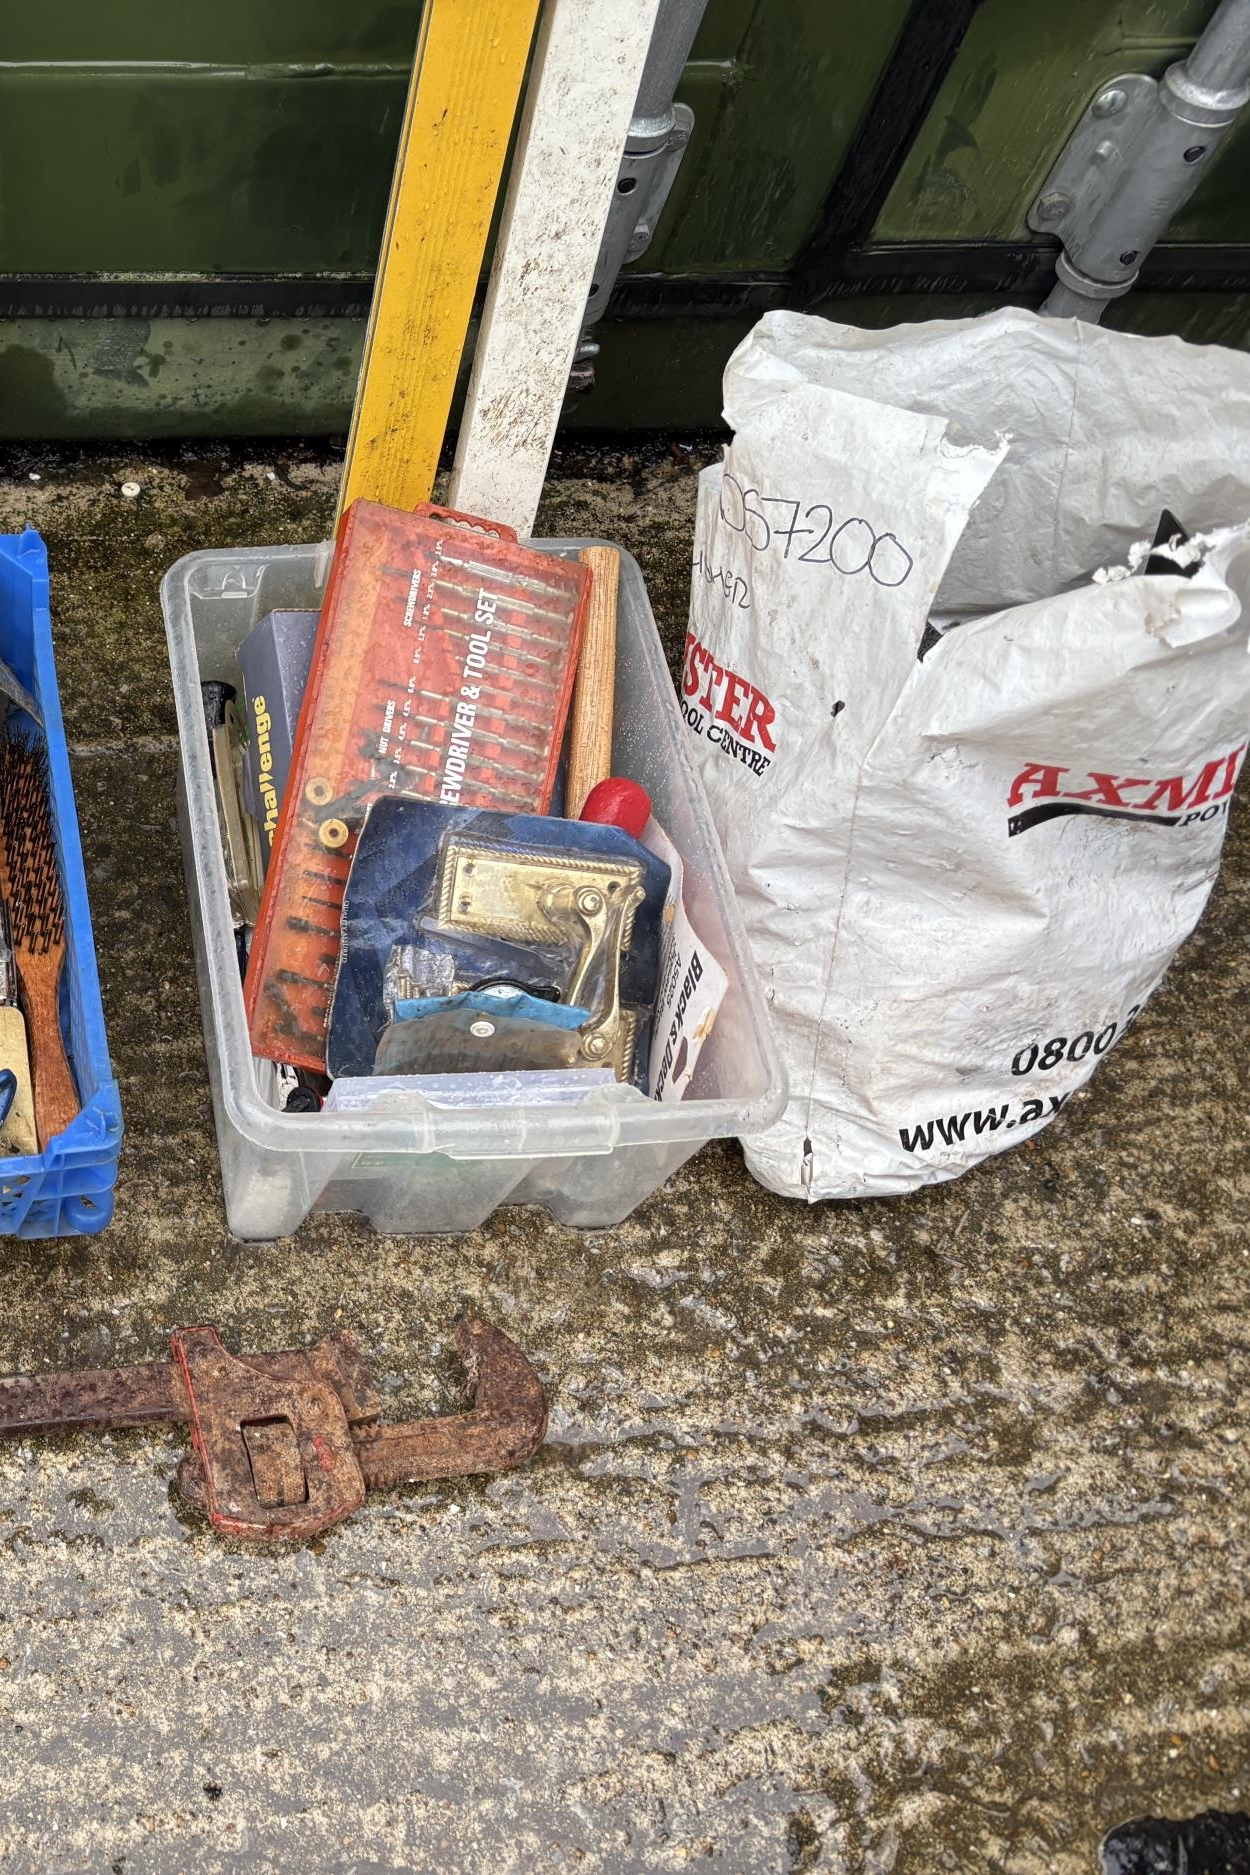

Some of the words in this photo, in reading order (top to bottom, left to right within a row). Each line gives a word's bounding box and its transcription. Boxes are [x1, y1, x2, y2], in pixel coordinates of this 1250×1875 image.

[403, 568, 422, 627] SCREWDRIVERS
[474, 587, 499, 626] SET
[462, 630, 492, 679] TOOL
[460, 683, 481, 700] &
[382, 699, 396, 733] DRIVERS
[378, 736, 389, 754] NUT
[706, 724, 772, 777] CENTRE
[674, 950, 704, 1029] Black
[669, 1020, 678, 1046] &
[1011, 1022, 1118, 1076] 0800
